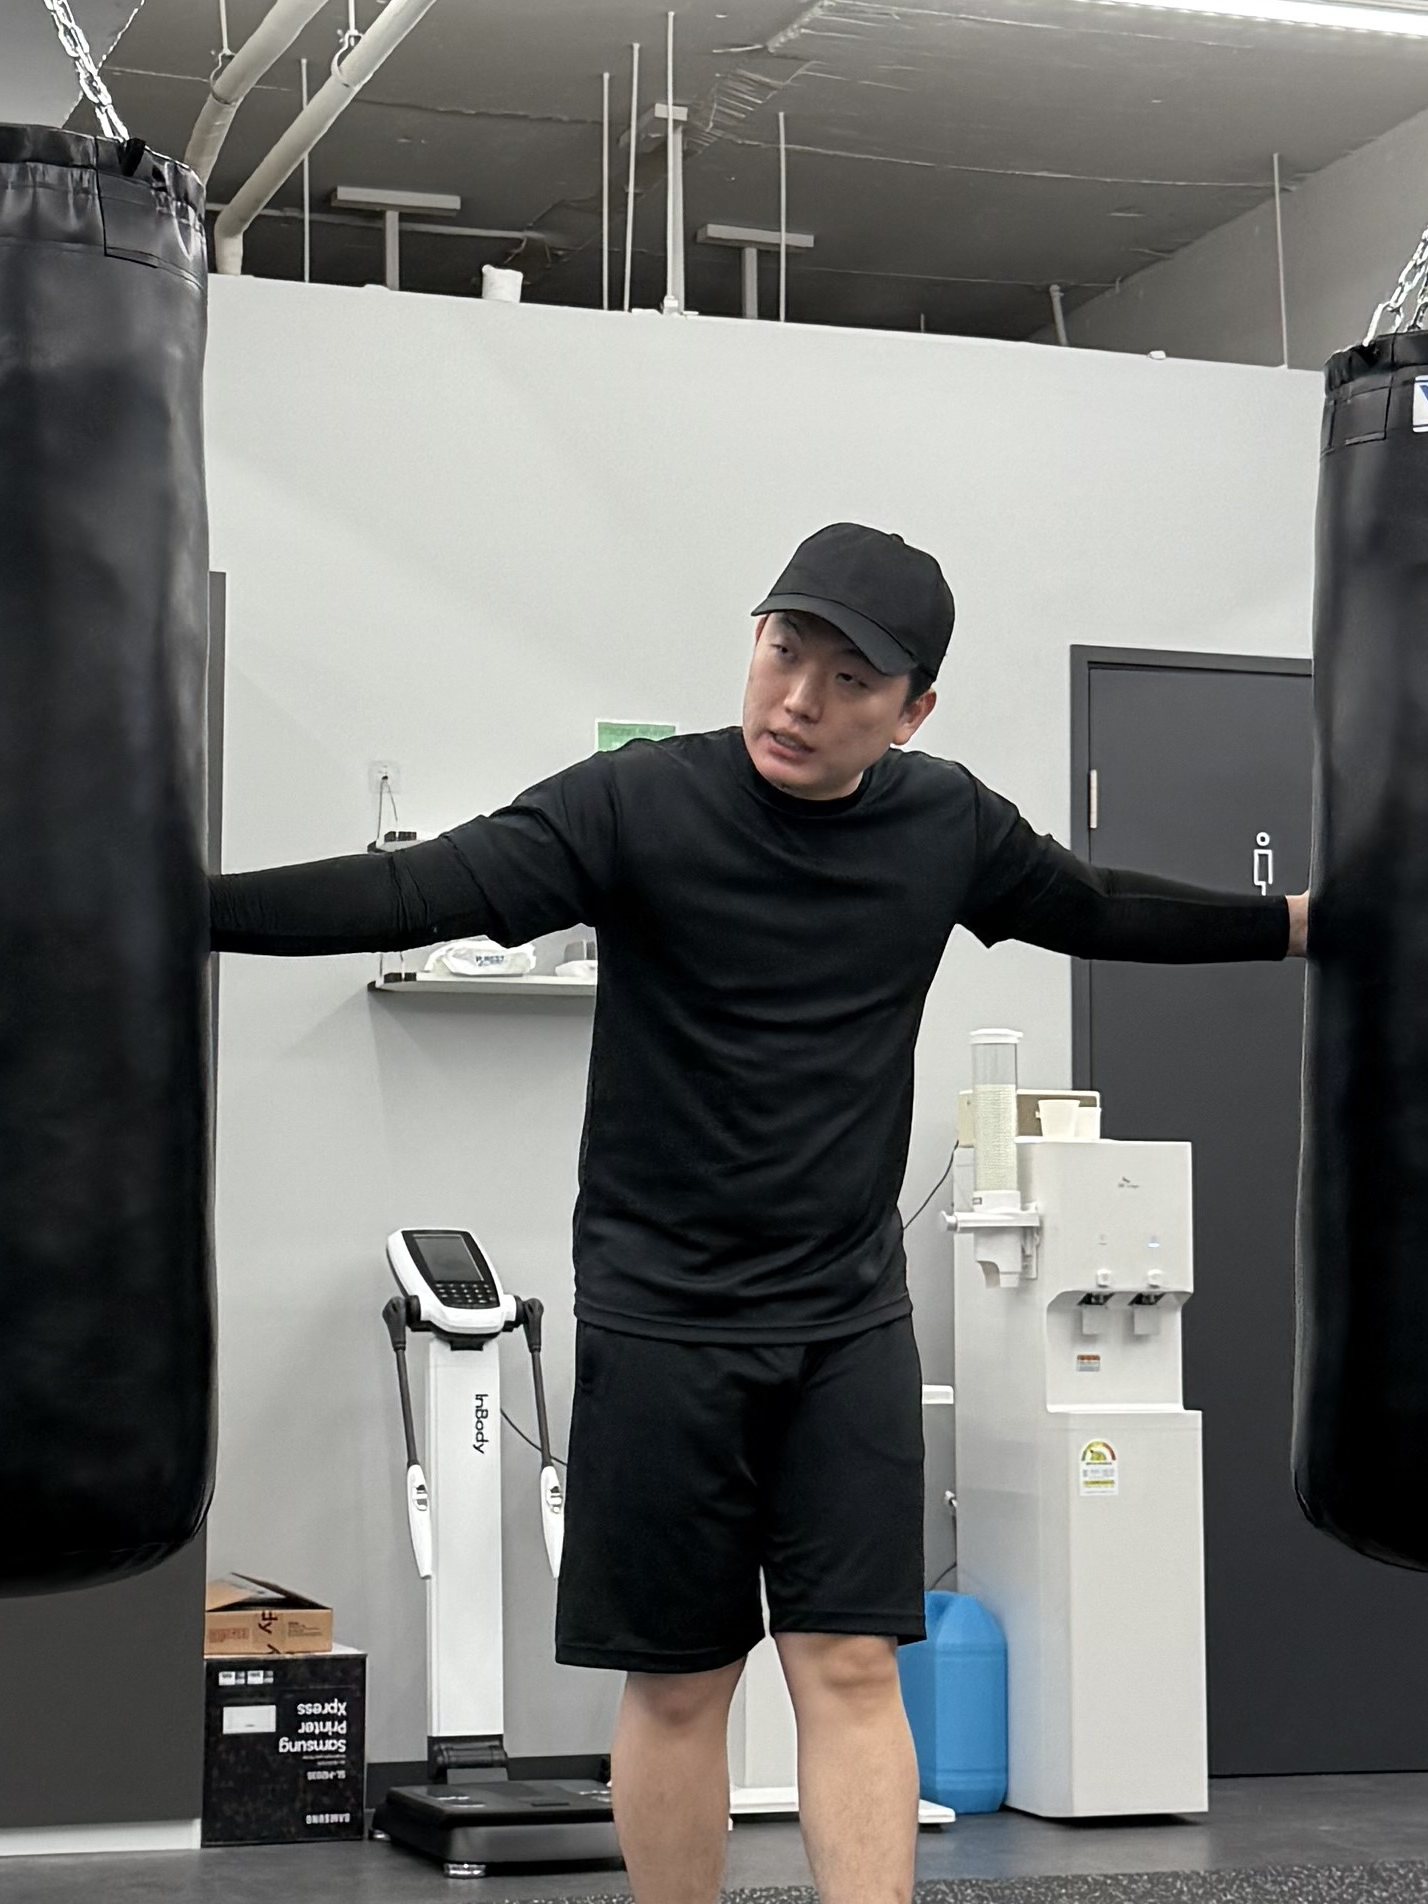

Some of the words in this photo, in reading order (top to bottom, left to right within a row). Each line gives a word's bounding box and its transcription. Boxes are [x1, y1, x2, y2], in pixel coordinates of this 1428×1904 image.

[472, 1393, 490, 1455] InBody
[296, 1698, 348, 1716] Xpress
[297, 1720, 347, 1736] Printer
[278, 1737, 347, 1753] Samsung
